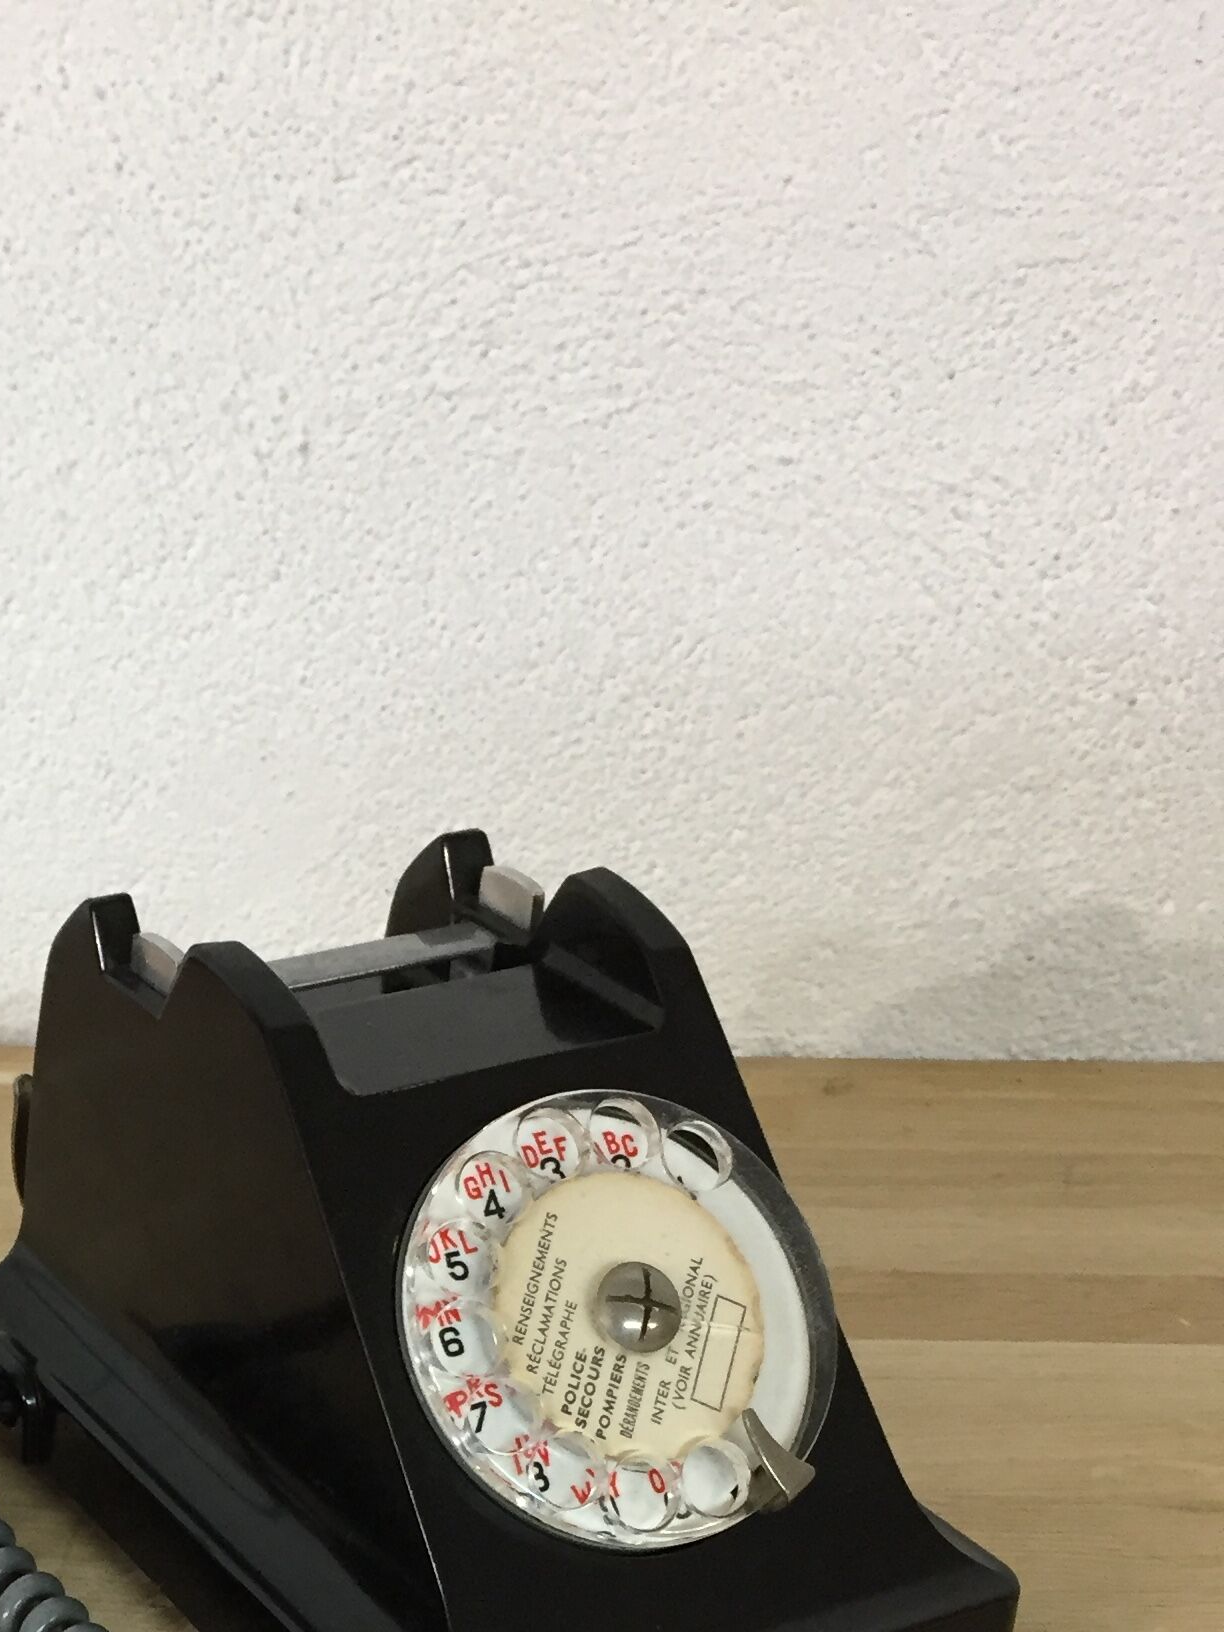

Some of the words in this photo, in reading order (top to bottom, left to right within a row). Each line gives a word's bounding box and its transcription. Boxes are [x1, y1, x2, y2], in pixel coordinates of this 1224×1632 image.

[521, 1130, 567, 1168] DEF
[463, 1162, 511, 1200] GHI
[483, 1188, 505, 1219] 4
[428, 1227, 478, 1264] JKL
[444, 1250, 469, 1281] 5
[512, 1211, 558, 1346] RENSEIGNEMENTS
[526, 1257, 568, 1375] RÉCLAMATIONS
[438, 1326, 465, 1357] 6
[542, 1299, 578, 1395] TÉLÉGRAPHE
[575, 1345, 606, 1429] SECOURS
[596, 1353, 627, 1440] POMPIERS
[650, 1380, 671, 1425] INTER
[671, 1365, 693, 1410] (VOIR
[470, 1400, 487, 1433] 7
